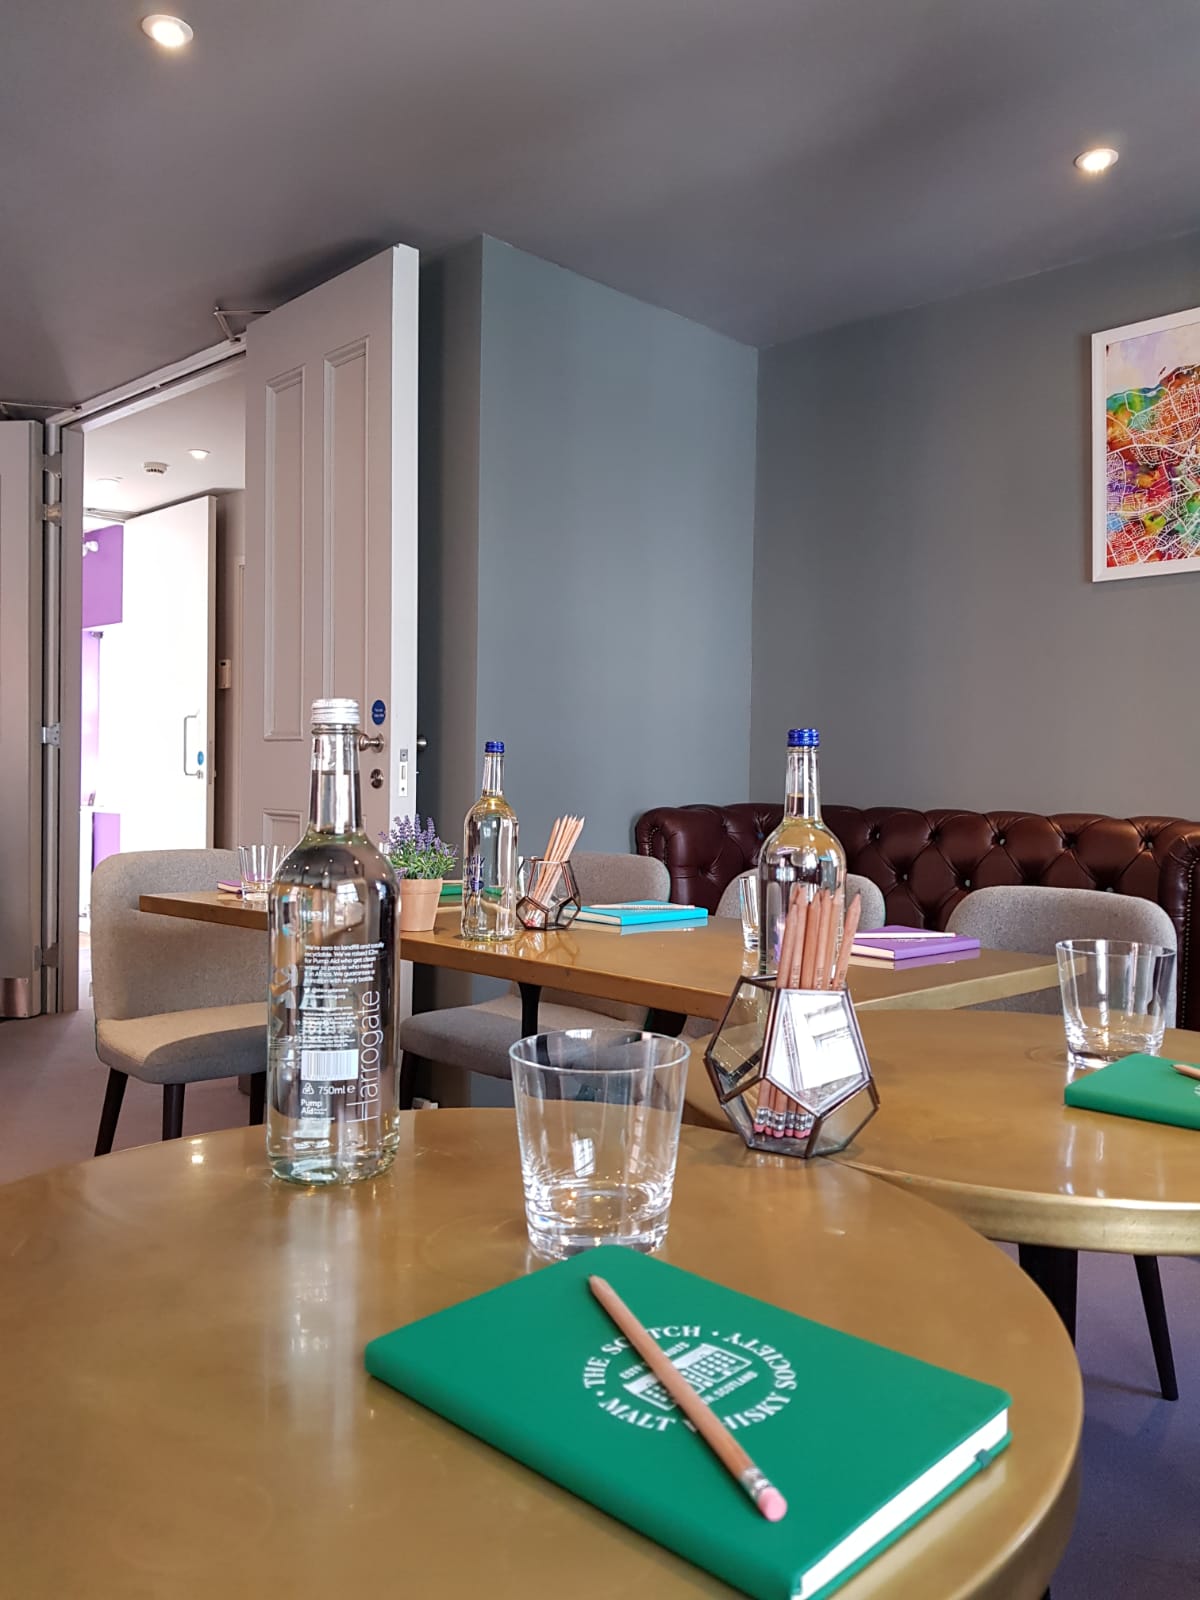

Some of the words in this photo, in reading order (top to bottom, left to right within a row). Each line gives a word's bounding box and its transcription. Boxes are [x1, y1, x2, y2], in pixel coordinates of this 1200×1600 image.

[313, 957, 330, 966] Pump
[346, 990, 384, 1123] Harrogate
[300, 1098, 323, 1109] Pump
[317, 1084, 346, 1096] 750ml
[600, 1325, 701, 1355] SCTCH
[583, 1356, 611, 1389] THE
[722, 1332, 798, 1390] SOCIETY
[598, 1397, 677, 1432] MALT
[682, 1391, 791, 1433] HISKY
